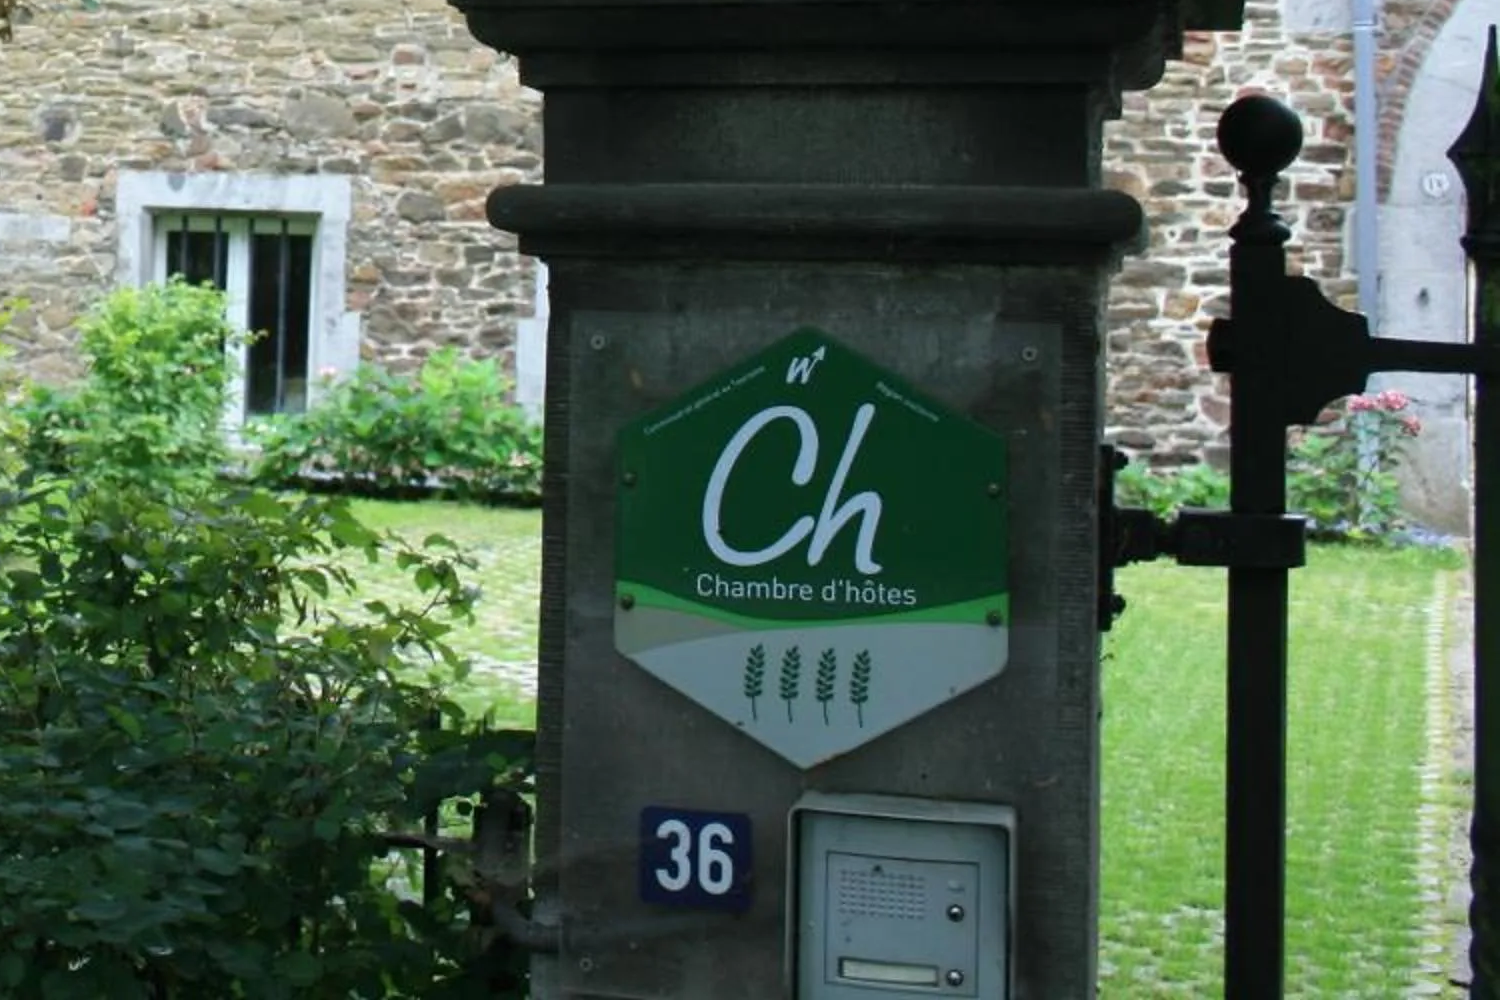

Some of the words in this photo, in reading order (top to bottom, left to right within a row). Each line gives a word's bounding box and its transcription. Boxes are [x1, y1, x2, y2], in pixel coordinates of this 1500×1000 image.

[703, 403, 883, 574] Ch
[696, 574, 813, 602] Chambre
[821, 578, 917, 606] d'hôtes
[655, 819, 734, 895] 36
